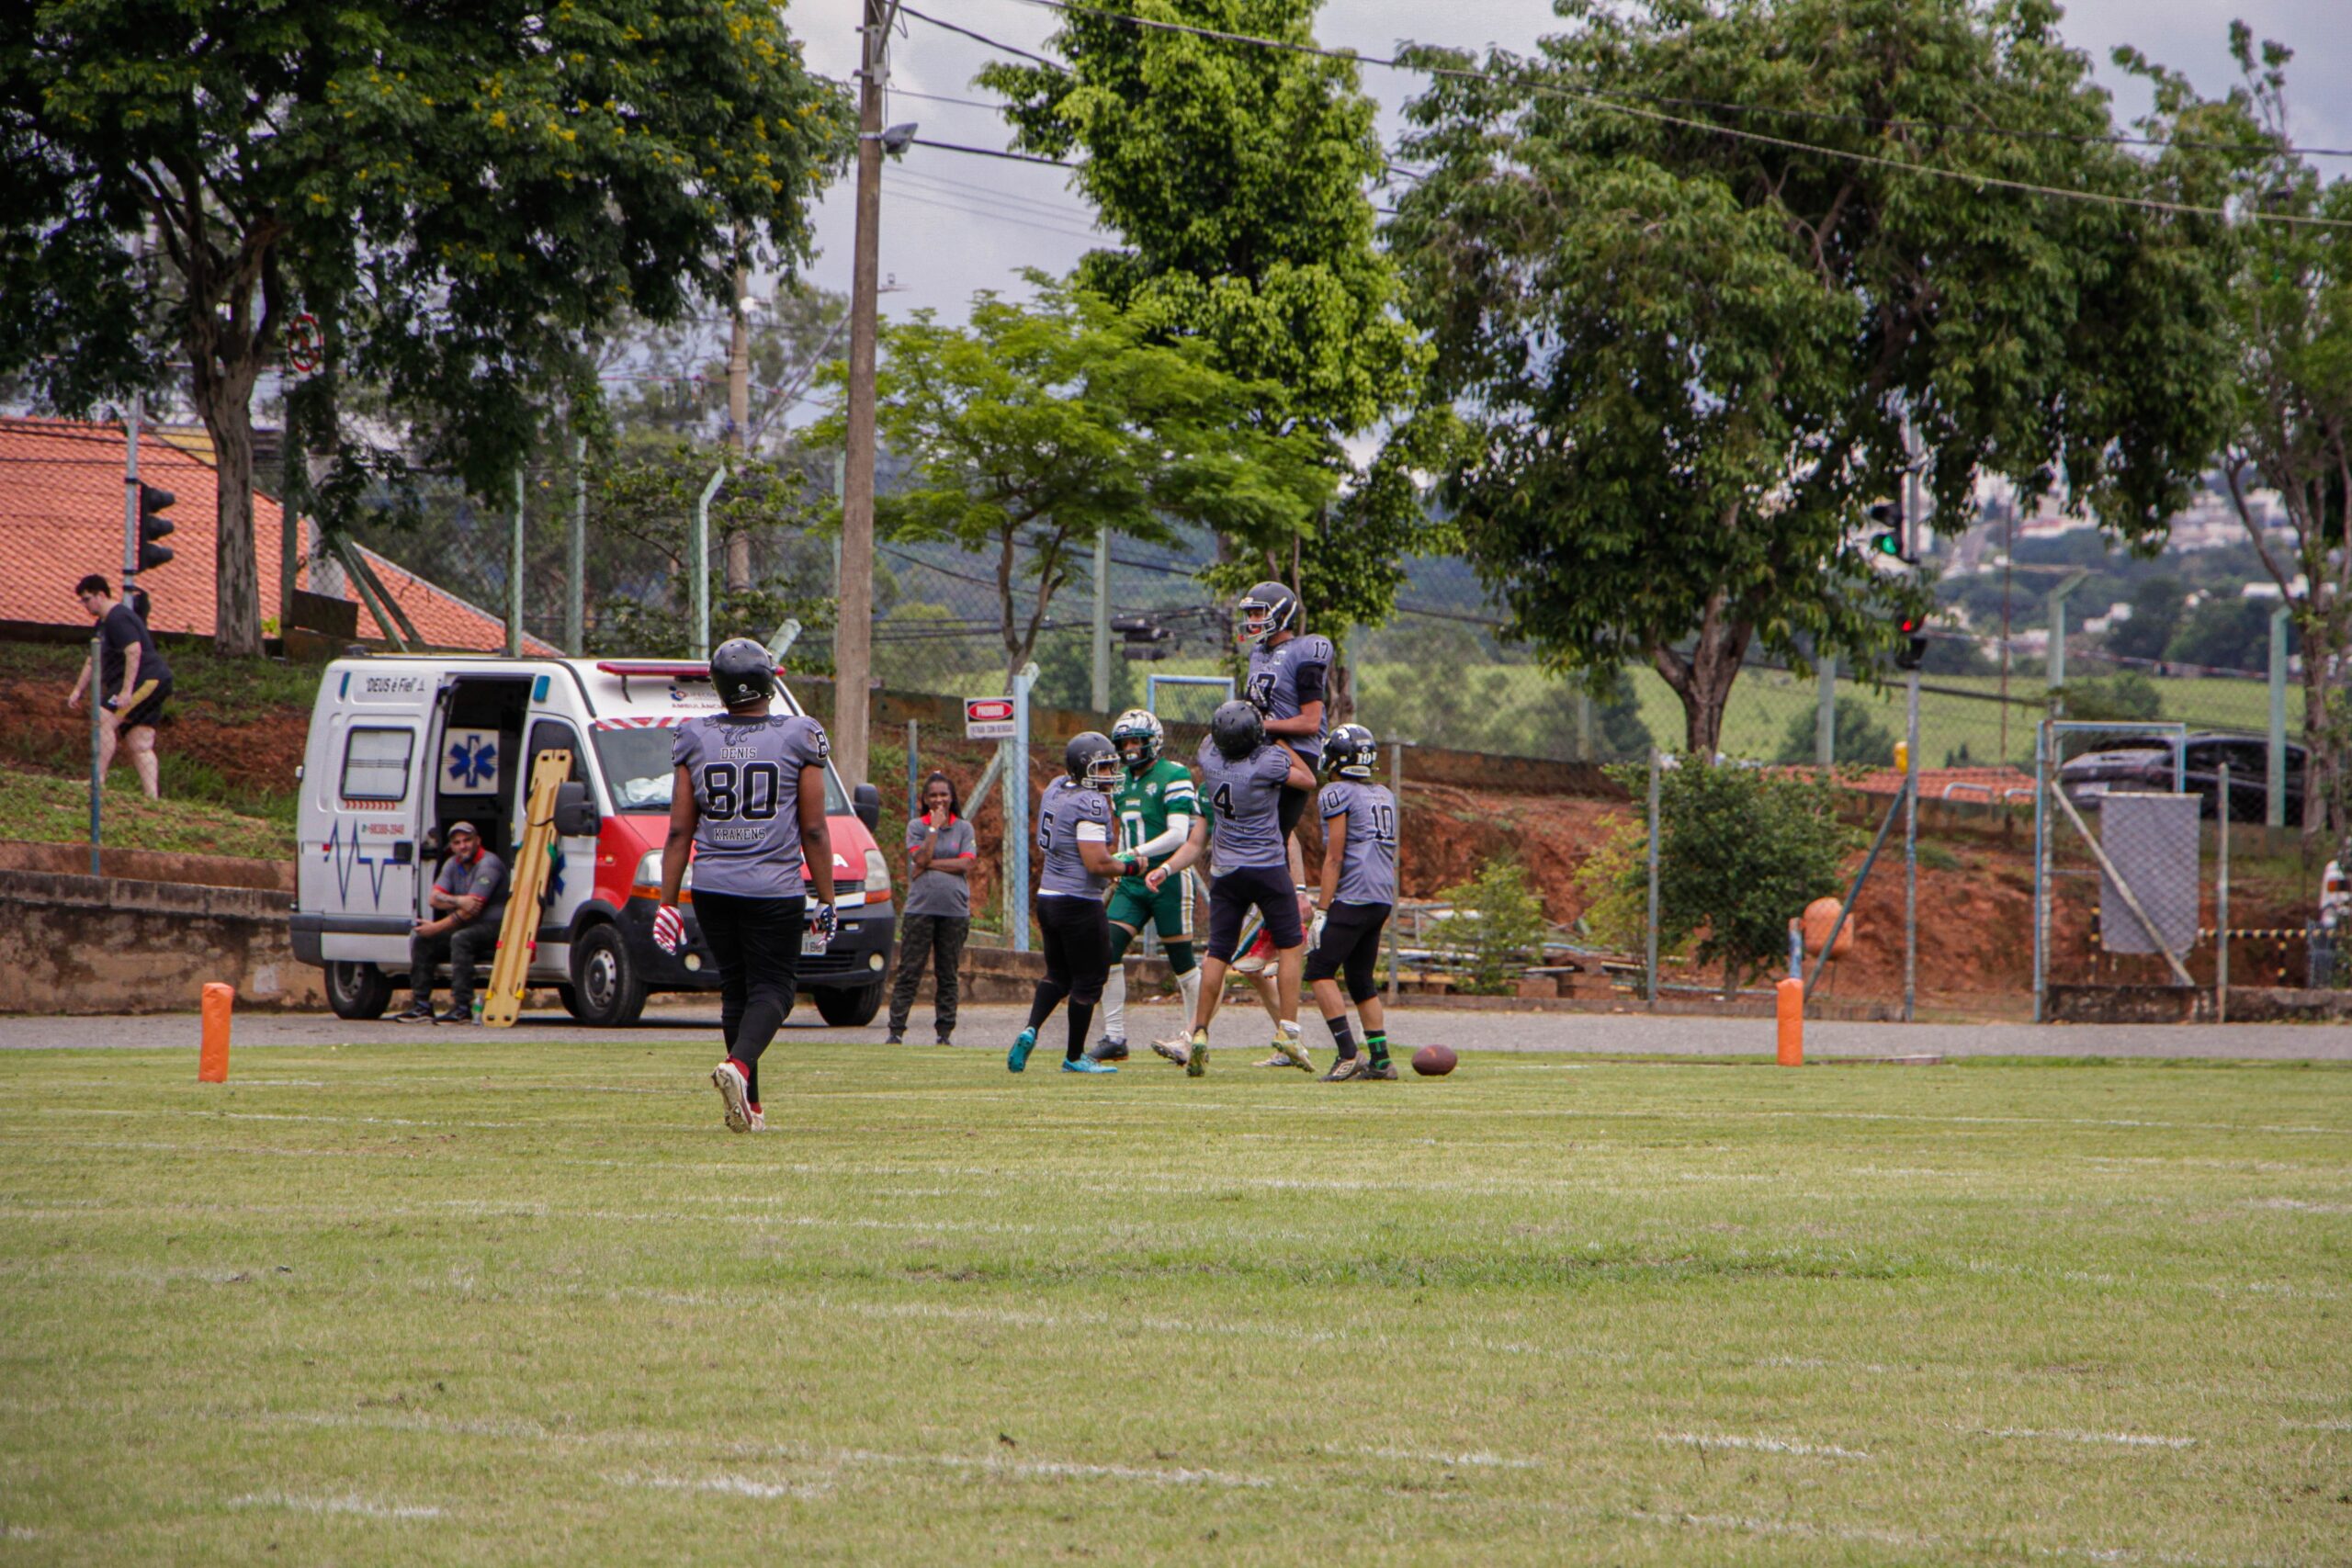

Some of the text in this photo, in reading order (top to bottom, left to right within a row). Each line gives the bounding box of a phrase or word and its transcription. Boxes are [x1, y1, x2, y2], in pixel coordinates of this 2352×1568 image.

[1313, 639, 1329, 660] 17
[720, 747, 758, 760] DENIS
[703, 761, 780, 822] 80
[1213, 781, 1238, 821] 4
[1322, 790, 1340, 811] 10
[714, 828, 766, 840] KRAKENS
[1038, 808, 1057, 852] 5
[1371, 802, 1396, 840] 10
